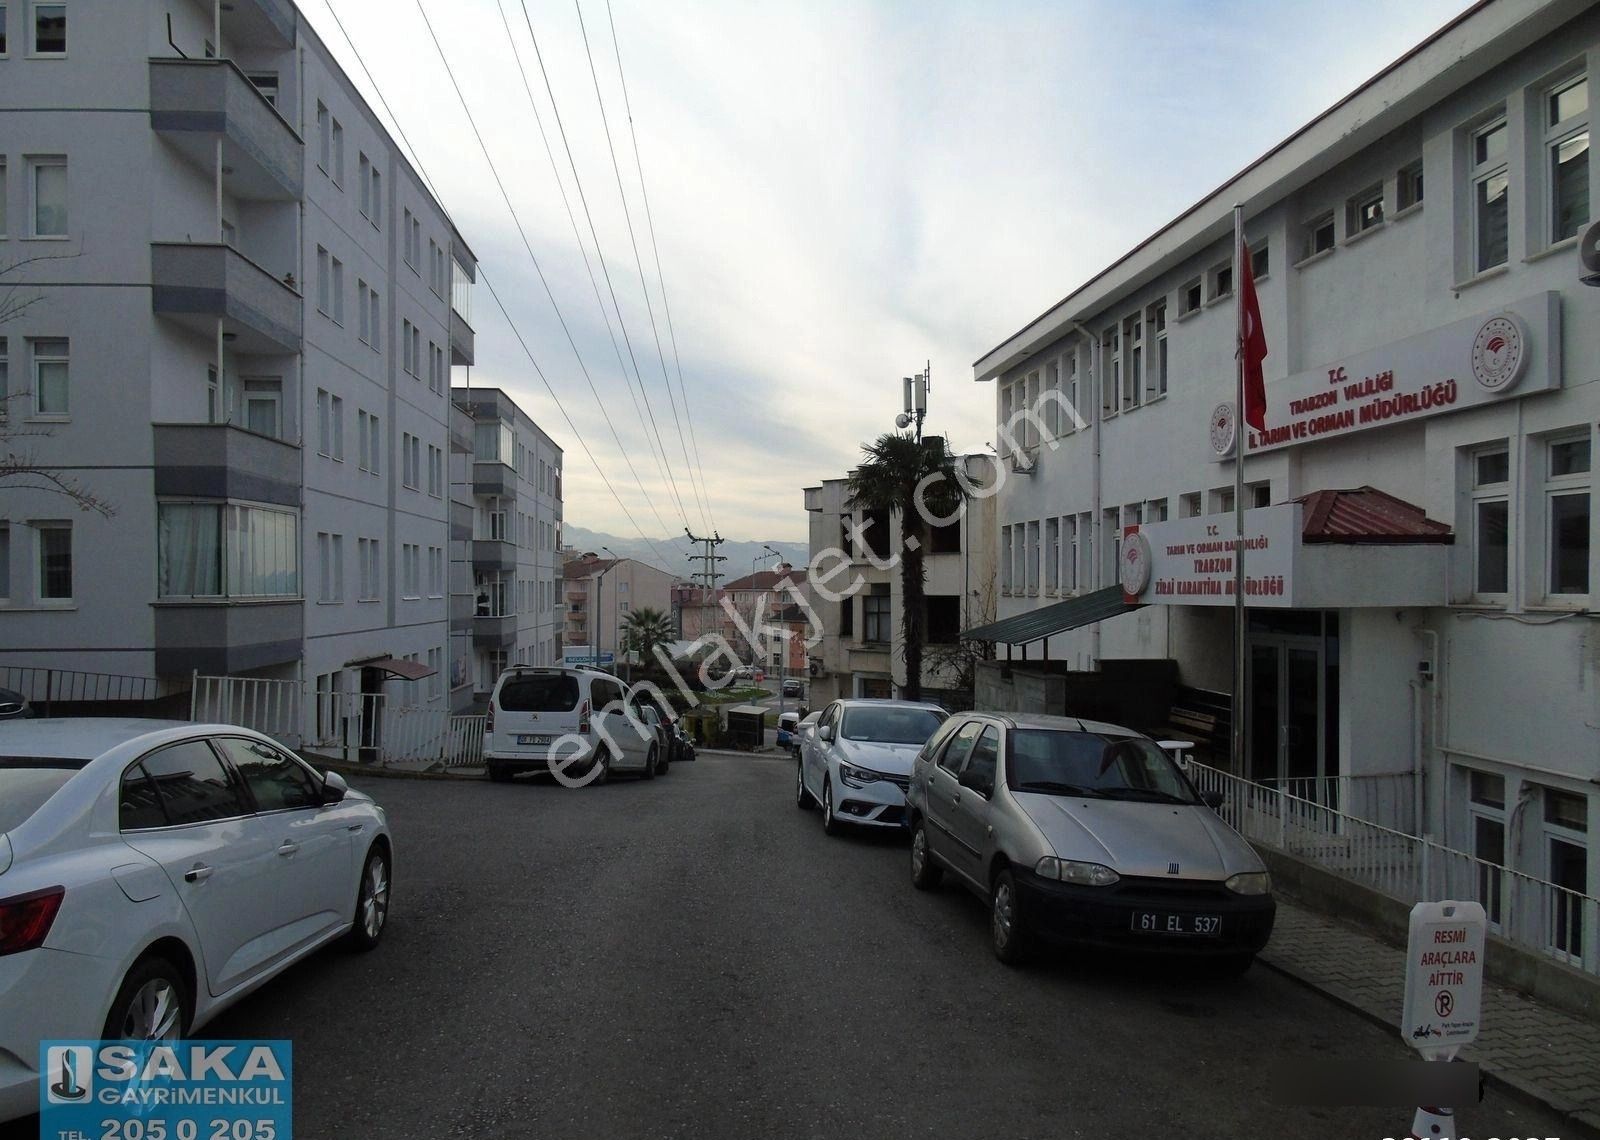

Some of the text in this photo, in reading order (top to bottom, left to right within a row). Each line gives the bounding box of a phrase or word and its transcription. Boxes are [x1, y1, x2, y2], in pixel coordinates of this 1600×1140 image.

[1327, 366, 1348, 385] T.C.
[1289, 370, 1394, 416] TRABZON VALİLİĞİ
[1258, 424, 1292, 447] TARIM
[1291, 421, 1308, 440] VE
[1308, 408, 1355, 436] ORMAN
[1359, 378, 1458, 424] MÜDÜRLÜĞÜ
[1166, 534, 1268, 556] TARIM VE ORMAN BANLIĞI
[1193, 558, 1232, 574] TRABZON
[1176, 577, 1222, 596] KARANTİNA
[1225, 575, 1283, 596] MÜRLÜĞÜ
[1141, 913, 1219, 932] 61 EL 537
[1434, 927, 1467, 944] RESMİ
[1420, 951, 1476, 968] ARAÇLARA
[1428, 971, 1464, 986] AİTTİR
